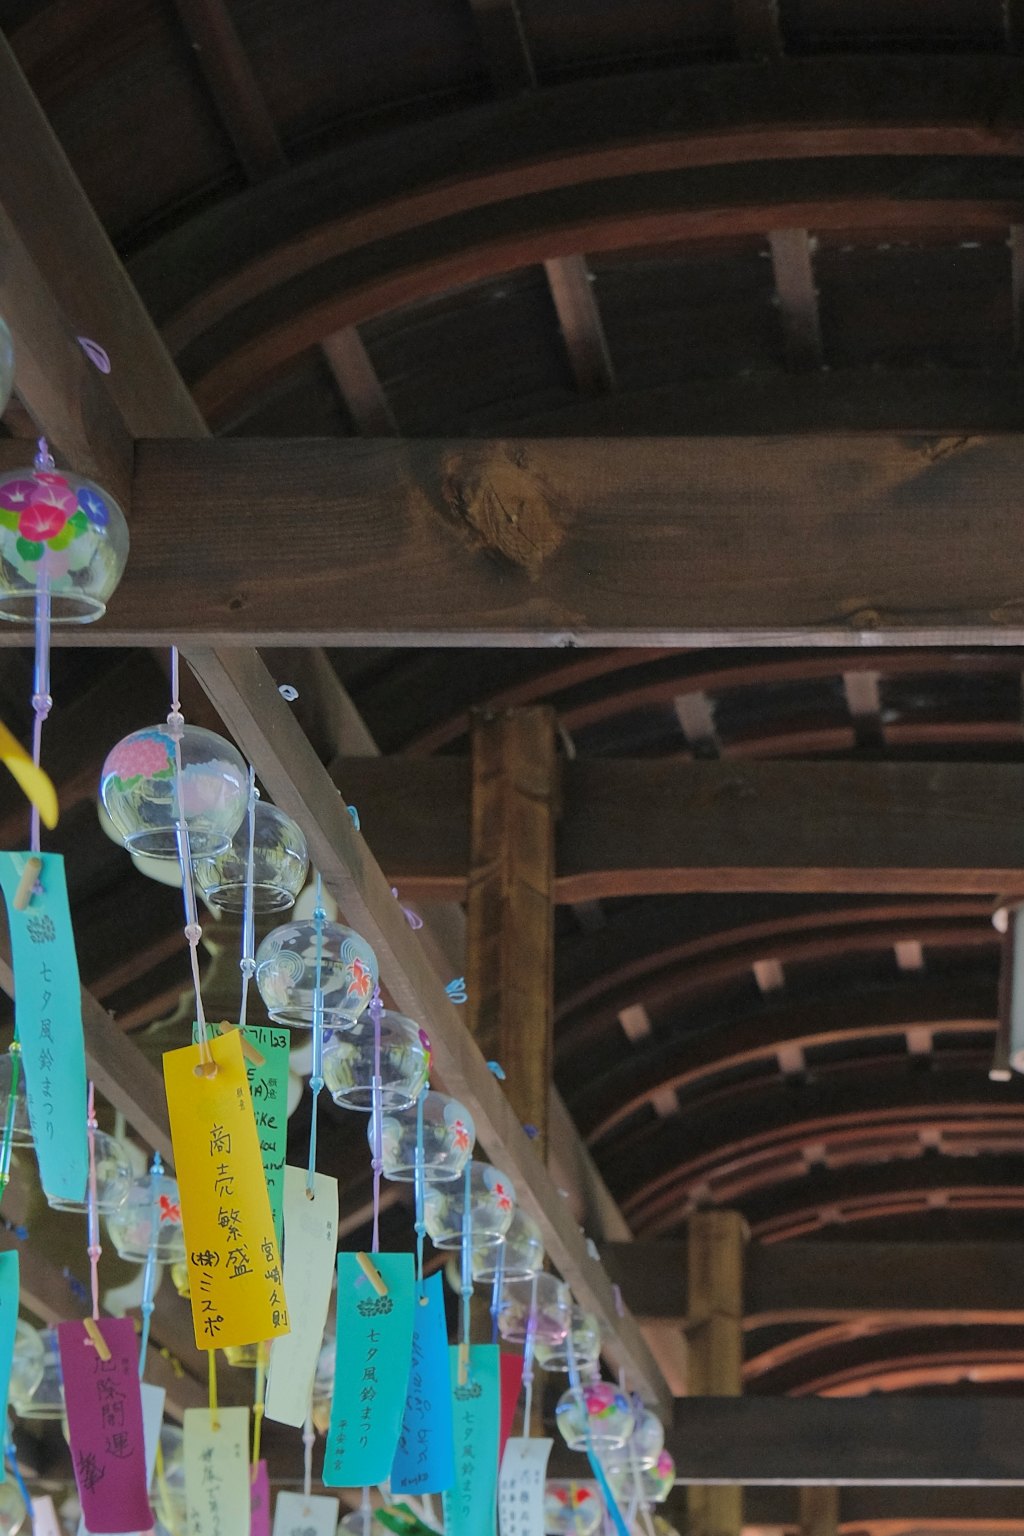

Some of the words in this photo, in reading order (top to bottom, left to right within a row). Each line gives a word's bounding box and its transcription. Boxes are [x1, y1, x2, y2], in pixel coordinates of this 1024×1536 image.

[39, 961, 55, 1140] 七夕風鈴まつり
[209, 1123, 254, 1279] 商売繁盛
[359, 1328, 381, 1448] 七夕風鈴まつり
